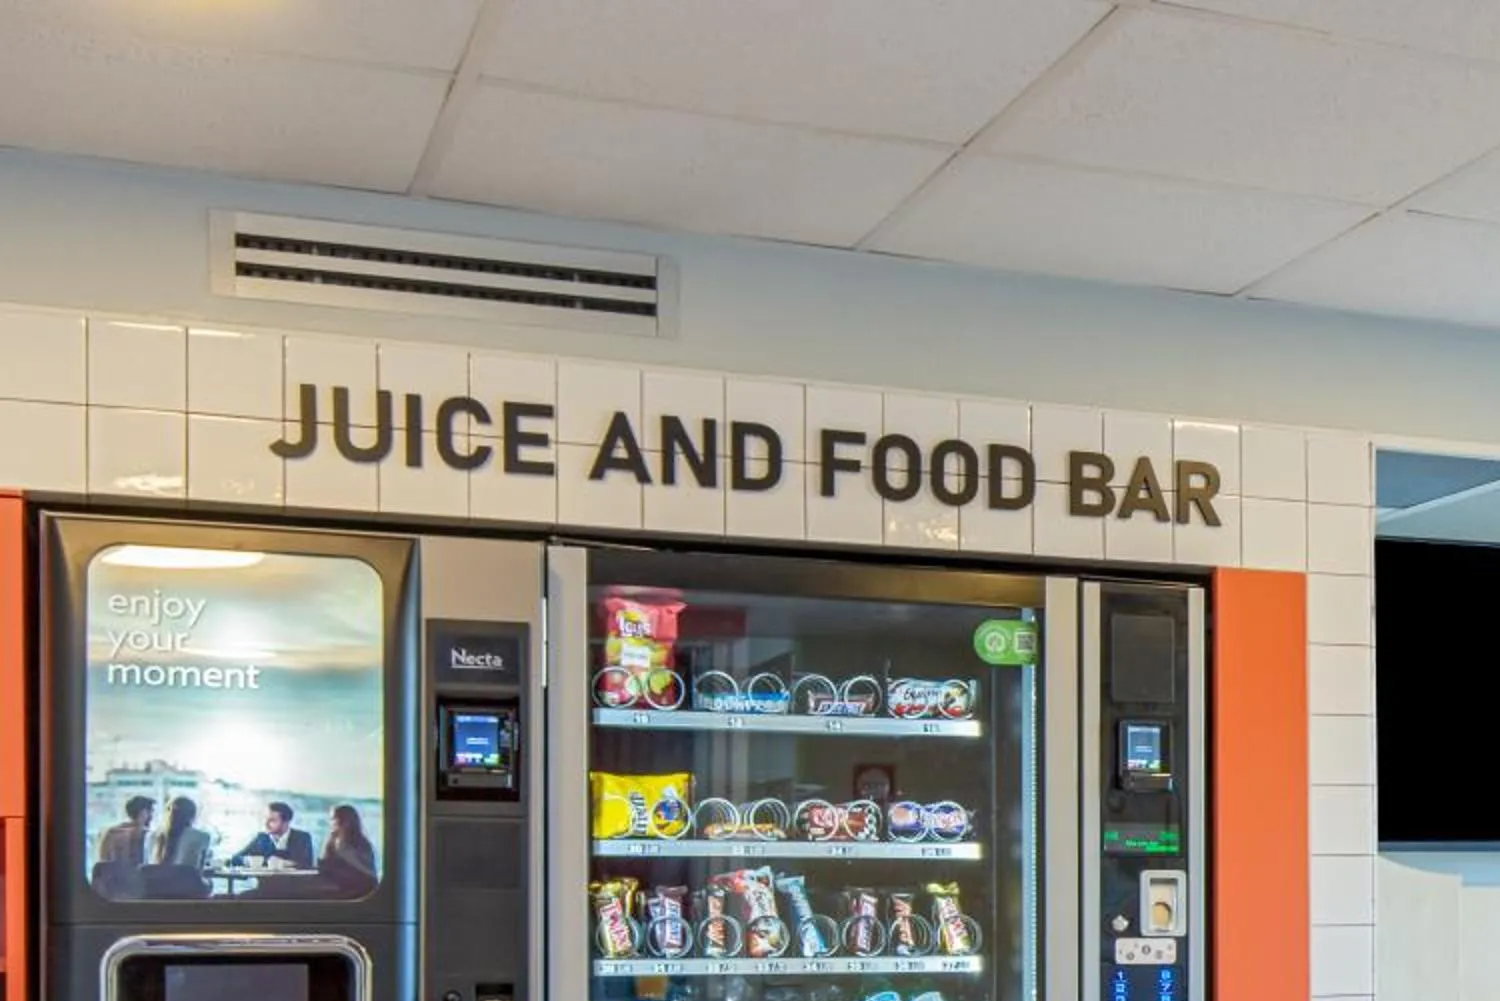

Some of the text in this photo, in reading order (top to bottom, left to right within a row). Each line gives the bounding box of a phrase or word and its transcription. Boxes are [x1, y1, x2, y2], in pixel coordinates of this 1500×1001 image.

[269, 383, 1222, 527] JUICE AND FOOD BAR
[108, 589, 207, 629] enjoy
[108, 630, 190, 660] your
[451, 648, 504, 669] Necta
[108, 663, 261, 690] moment
